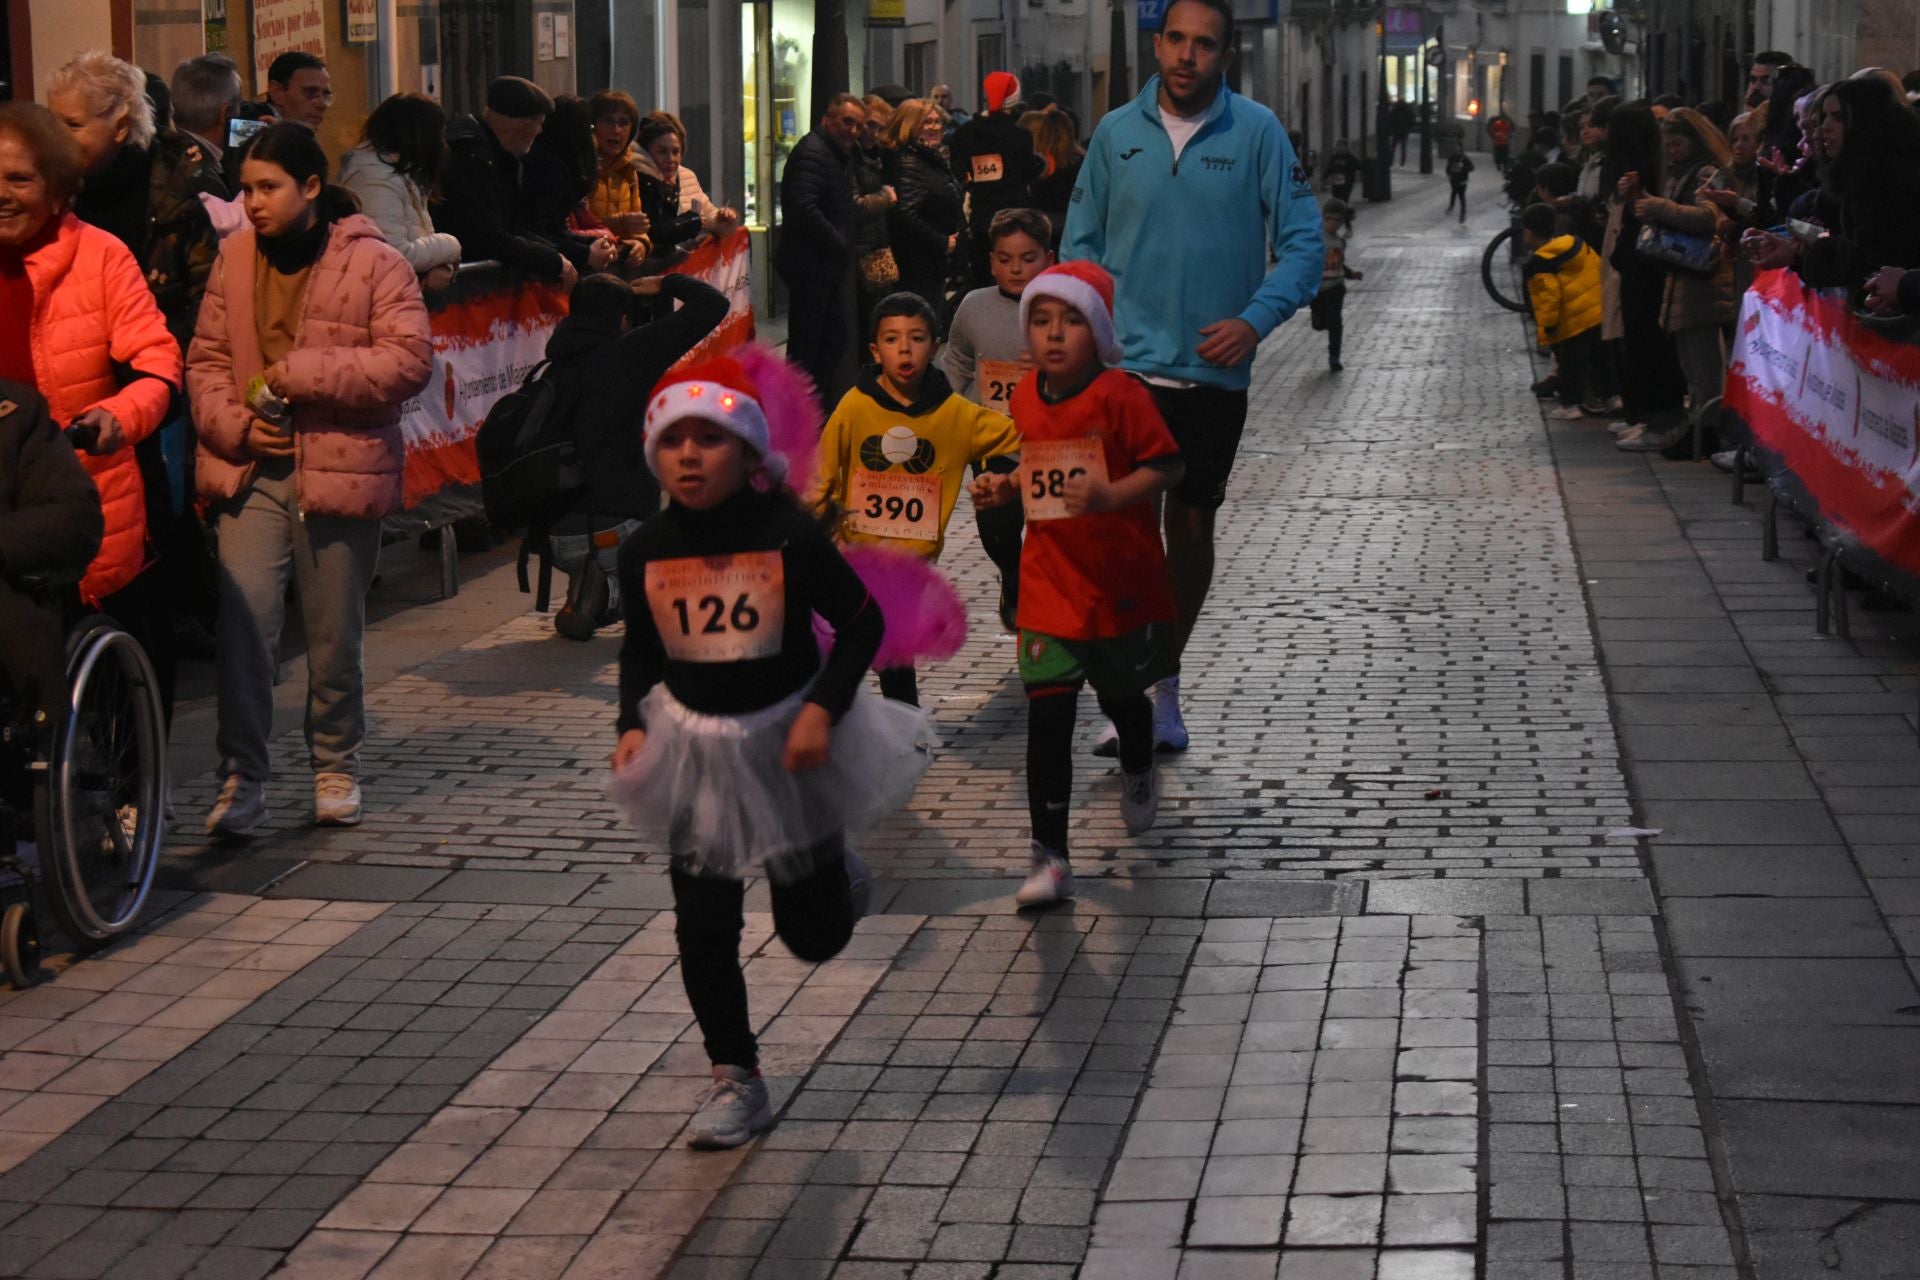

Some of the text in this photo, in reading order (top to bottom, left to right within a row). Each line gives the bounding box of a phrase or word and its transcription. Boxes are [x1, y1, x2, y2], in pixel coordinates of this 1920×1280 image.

[977, 163, 997, 175] 564
[990, 381, 1018, 401] 28
[865, 494, 923, 522] 390
[673, 593, 759, 635] 126
